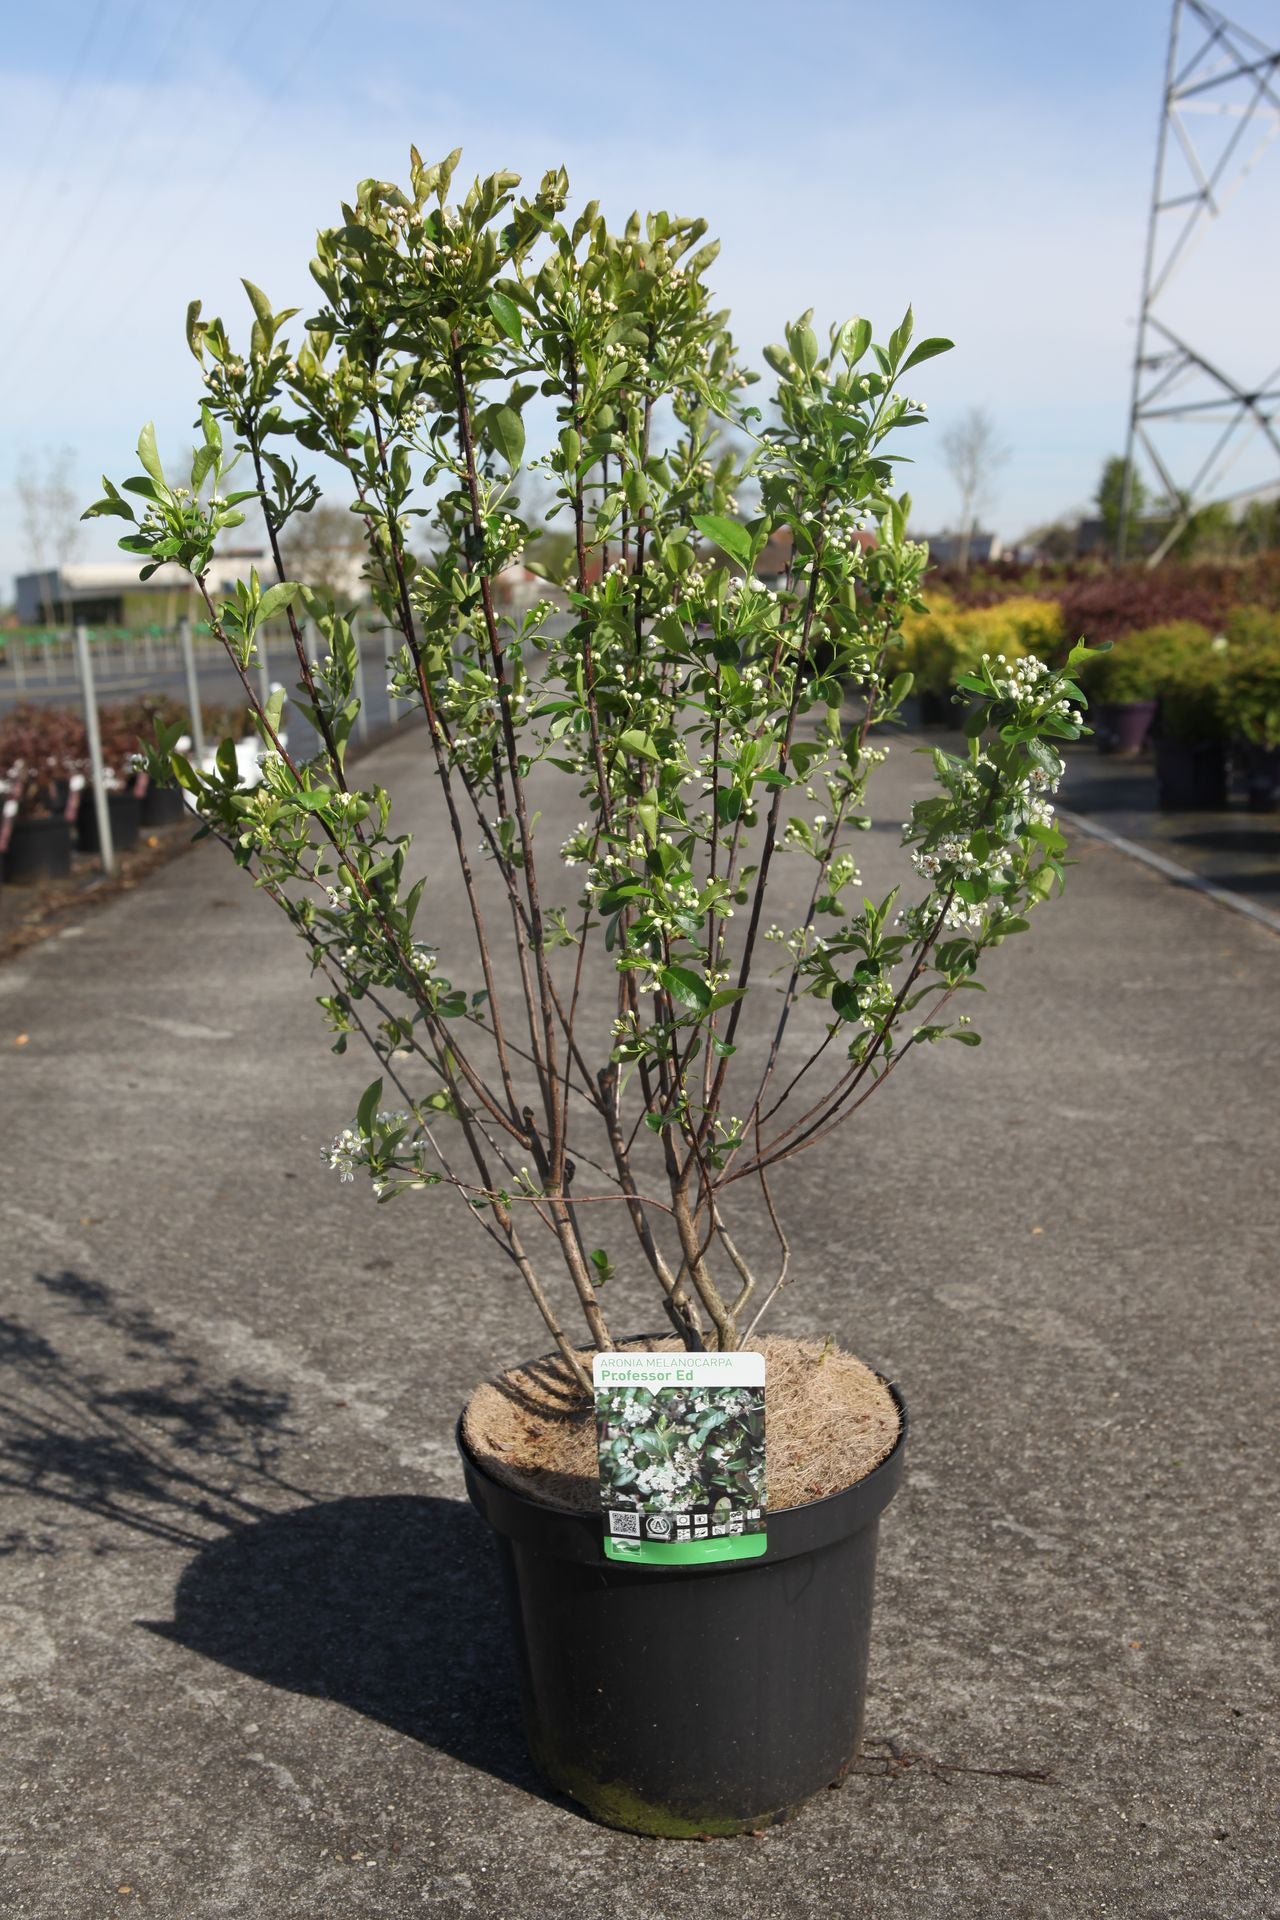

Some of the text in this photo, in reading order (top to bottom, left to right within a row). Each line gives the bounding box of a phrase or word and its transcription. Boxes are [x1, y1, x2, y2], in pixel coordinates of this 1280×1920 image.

[600, 1358, 733, 1368] ARONIA MELANOCARPA
[601, 1370, 694, 1381] Professor Ed
